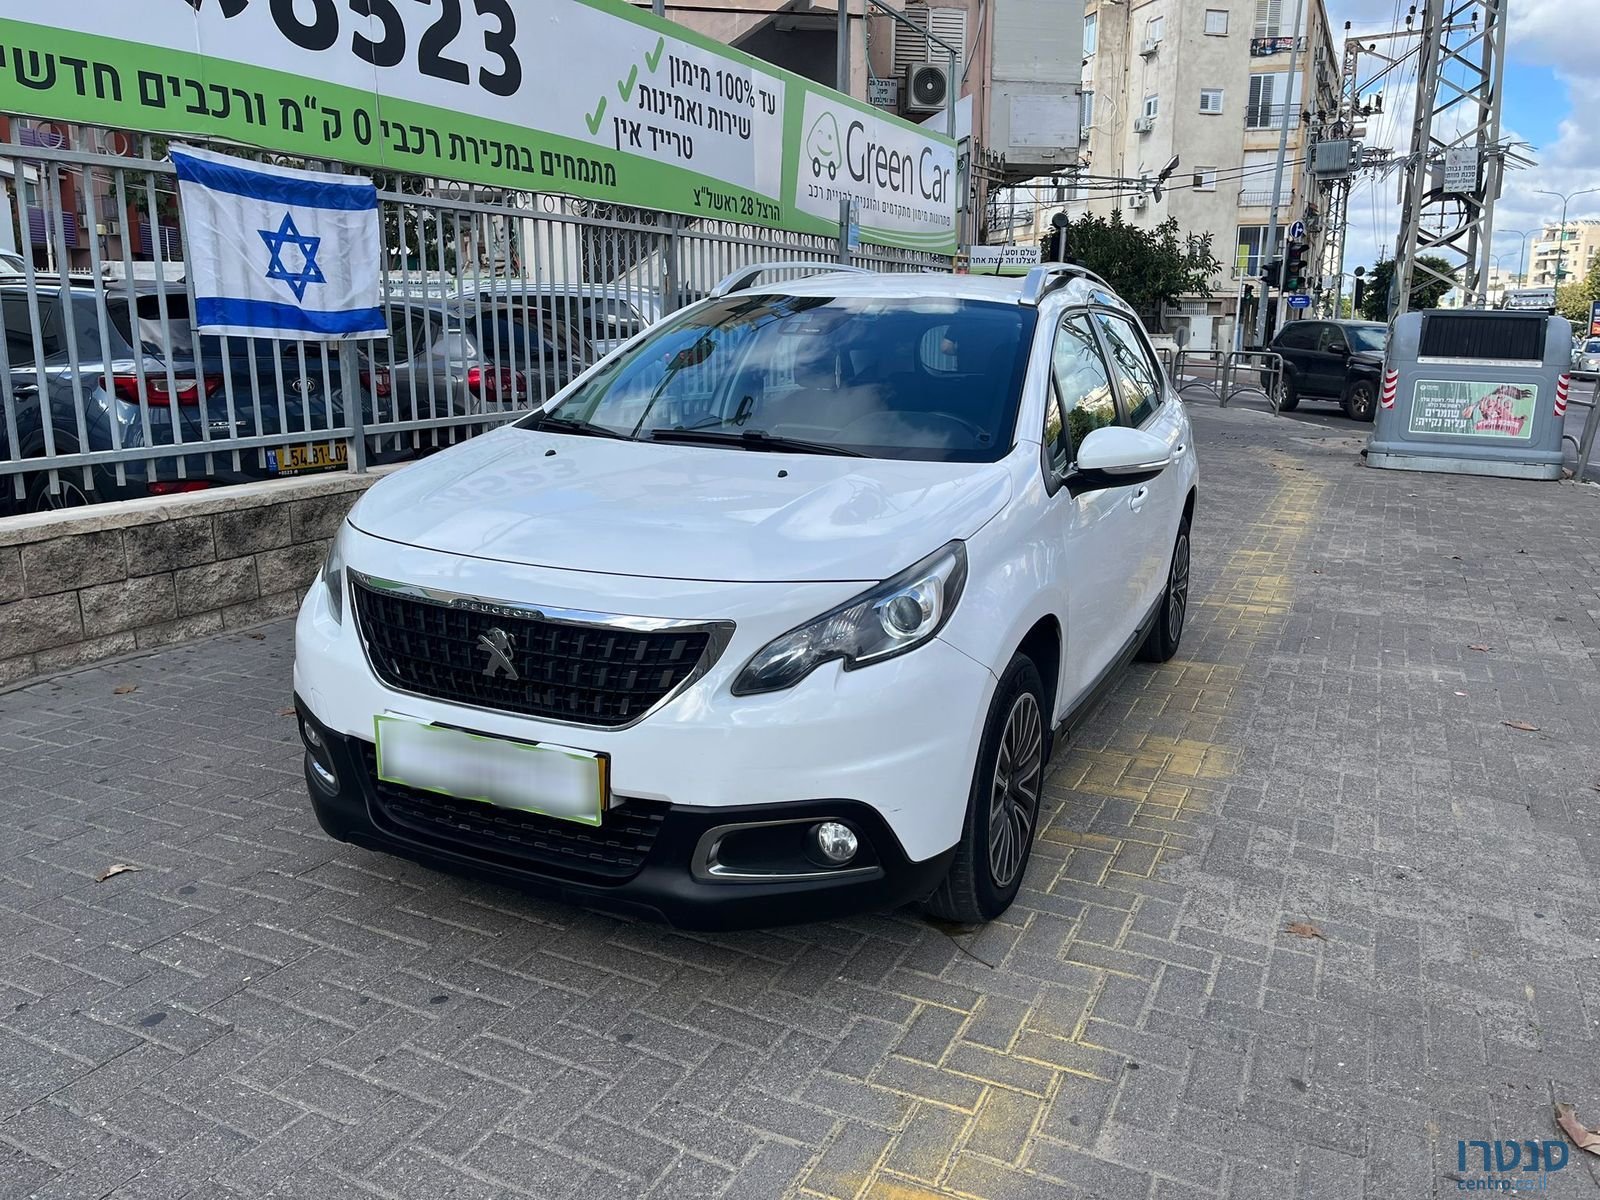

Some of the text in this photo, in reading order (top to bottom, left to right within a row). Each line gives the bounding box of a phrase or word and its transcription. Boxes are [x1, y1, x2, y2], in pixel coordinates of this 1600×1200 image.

[137, 69, 267, 126] ורכבים
[669, 55, 776, 115] עד 100% מימון
[278, 94, 343, 142] ק"מ
[353, 108, 372, 146] 0
[638, 84, 751, 140] שירות ואמינות
[380, 120, 442, 158] רכבי
[449, 132, 535, 173] במכירת
[613, 117, 693, 159] טרייד אין
[540, 150, 617, 187] מתמחים
[846, 120, 951, 204] Green Car
[693, 186, 780, 221] הרצל 28 ראשל"צ
[808, 183, 824, 199] רכב
[882, 201, 911, 219] מתקדמים
[912, 208, 928, 222] מימון
[1020, 248, 1037, 256] שלם
[1415, 416, 1443, 428] נקייה!
[1425, 408, 1460, 418] שומרים
[1444, 417, 1467, 428] עליה
[461, 601, 534, 618] PEUGEOT
